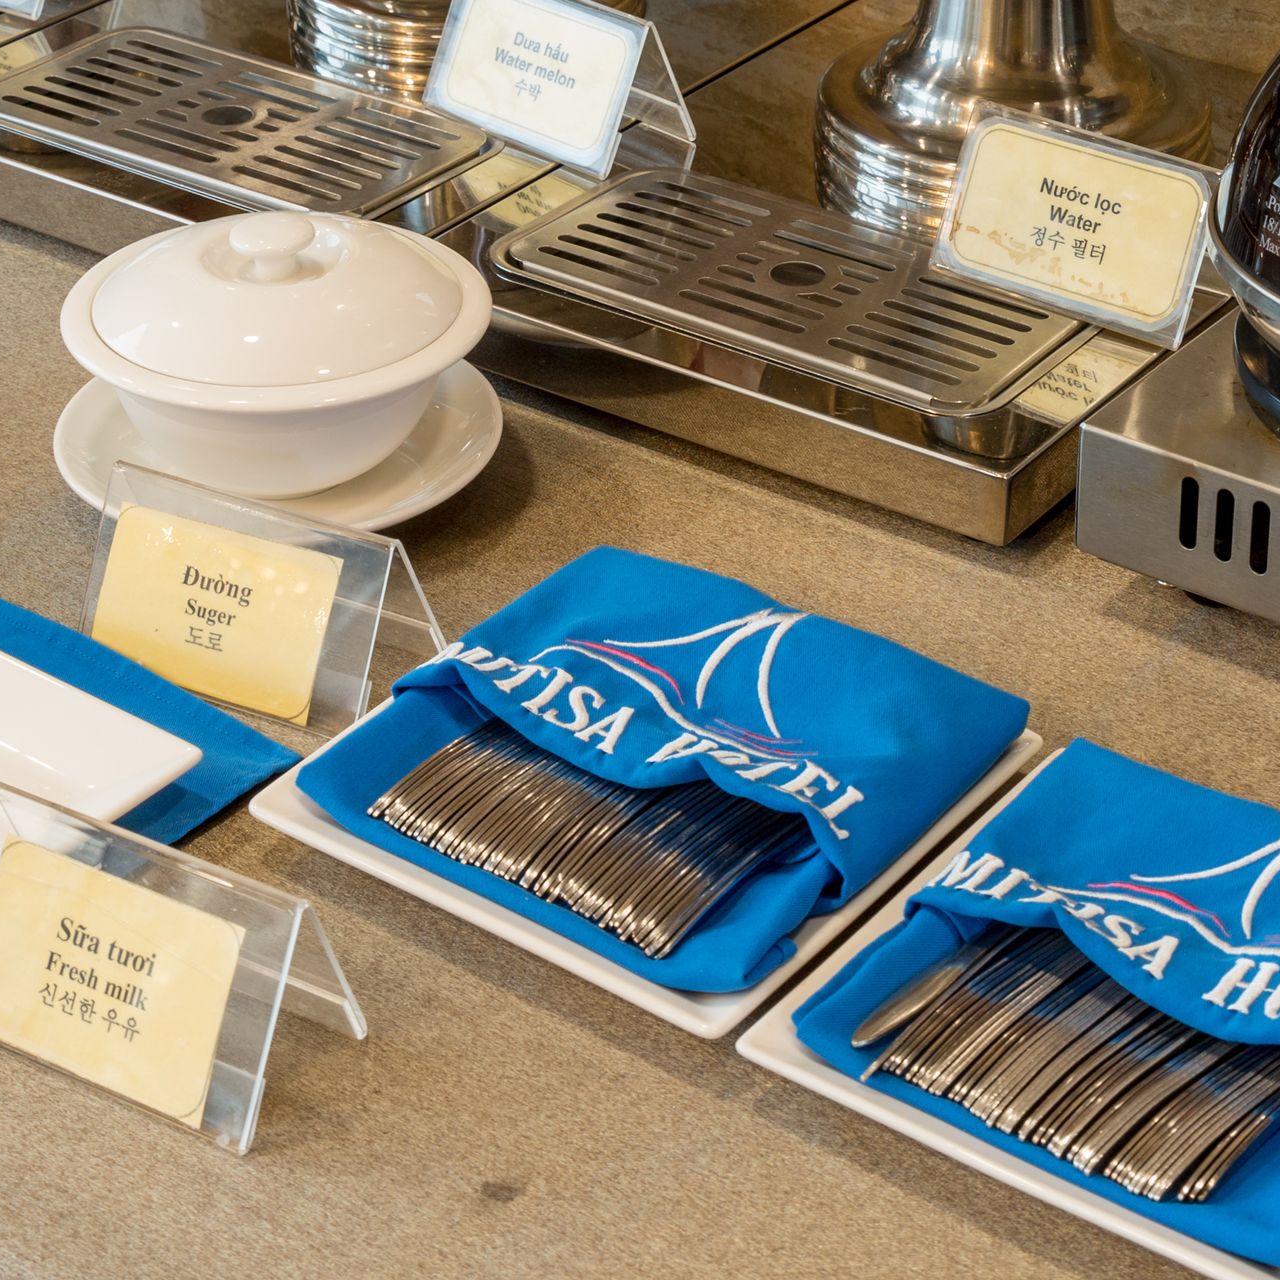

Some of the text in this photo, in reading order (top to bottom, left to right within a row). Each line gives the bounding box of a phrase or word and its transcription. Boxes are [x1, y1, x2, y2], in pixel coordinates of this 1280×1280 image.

[513, 31, 570, 64] Dưa hấu
[494, 47, 576, 90] Water melon
[514, 80, 542, 102] 수박
[1040, 177, 1122, 215] Nước lọc
[1050, 205, 1101, 234] Water
[1030, 225, 1107, 265] 정수 필터
[182, 564, 253, 607] Đường
[184, 597, 236, 627] Suger
[184, 625, 223, 652] 도로
[56, 916, 157, 978] Sữa tươi
[45, 950, 149, 1011] Fresh milk
[38, 982, 140, 1042] 신선한 우유
